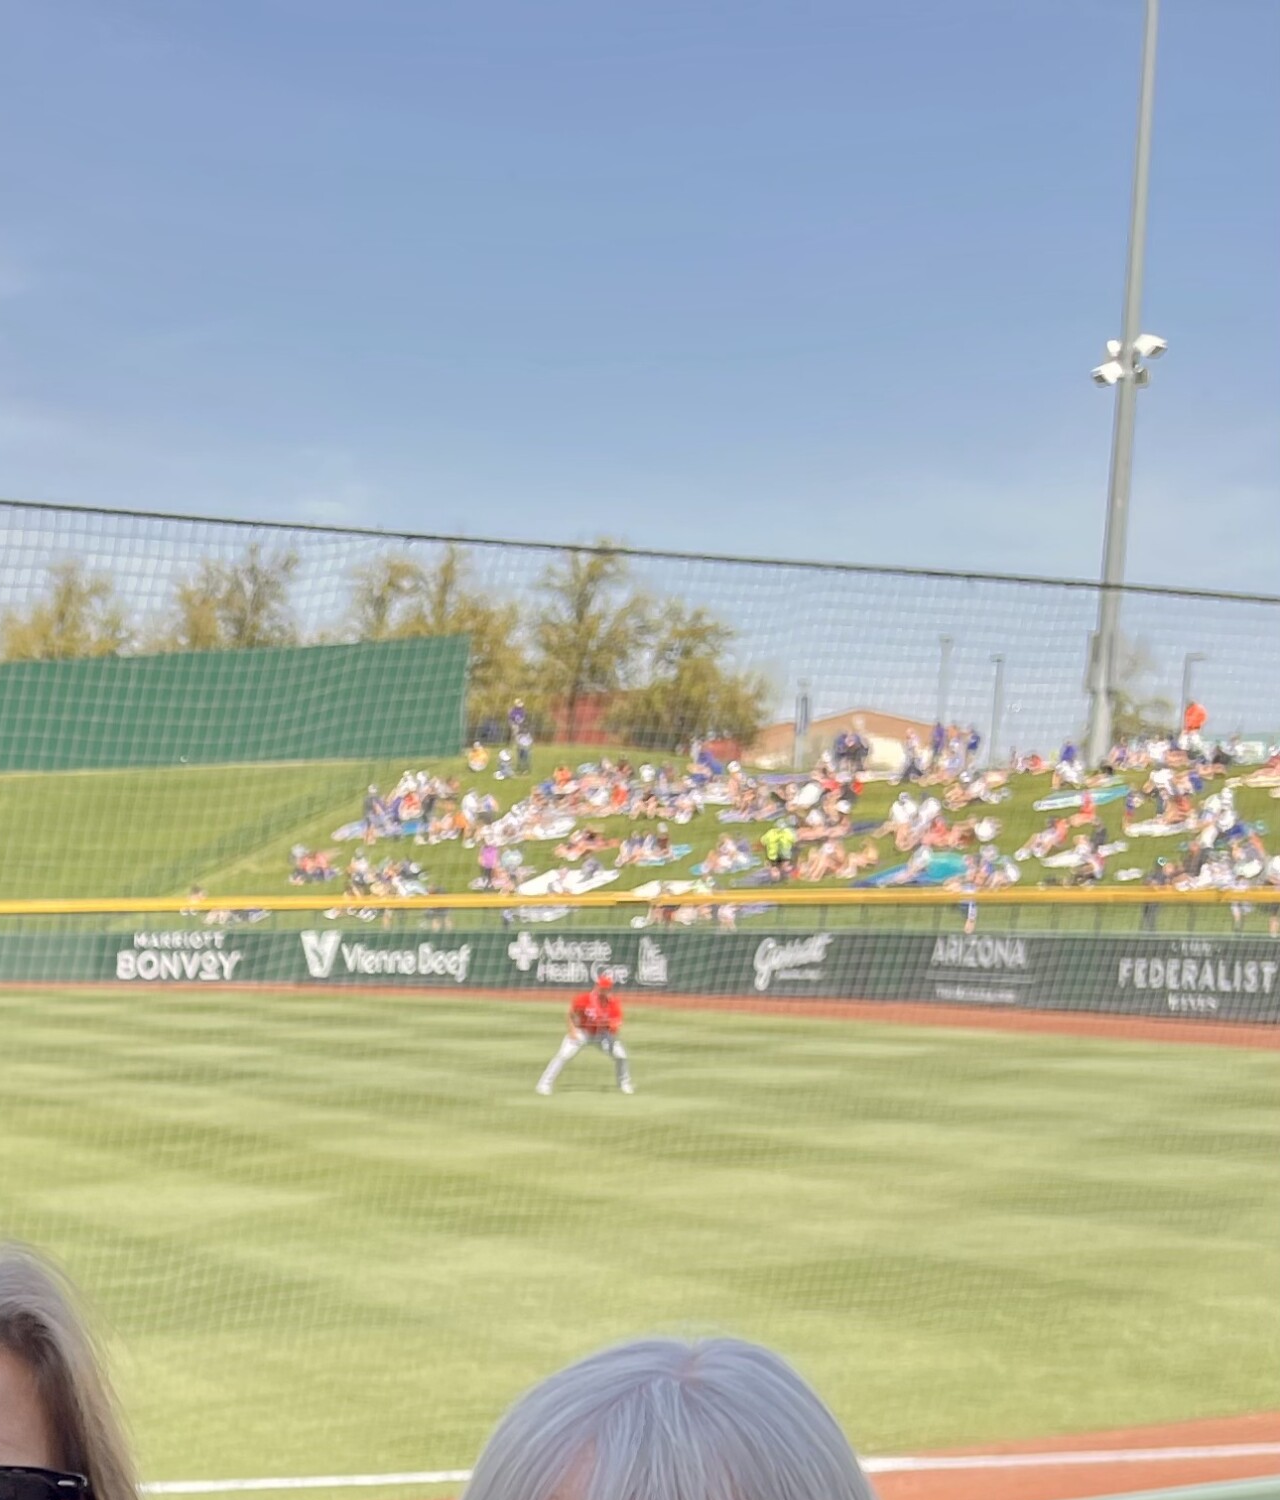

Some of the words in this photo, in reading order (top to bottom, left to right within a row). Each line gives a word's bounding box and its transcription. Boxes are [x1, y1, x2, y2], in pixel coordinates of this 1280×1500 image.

[133, 931, 225, 949] MARRIOTT
[539, 936, 612, 962] Advocate
[930, 936, 1028, 969] ARIZONA
[116, 950, 242, 981] BONVOY
[341, 943, 416, 975] Vienna
[417, 942, 471, 983] Beef
[1117, 956, 1277, 994] FEDERALIST
